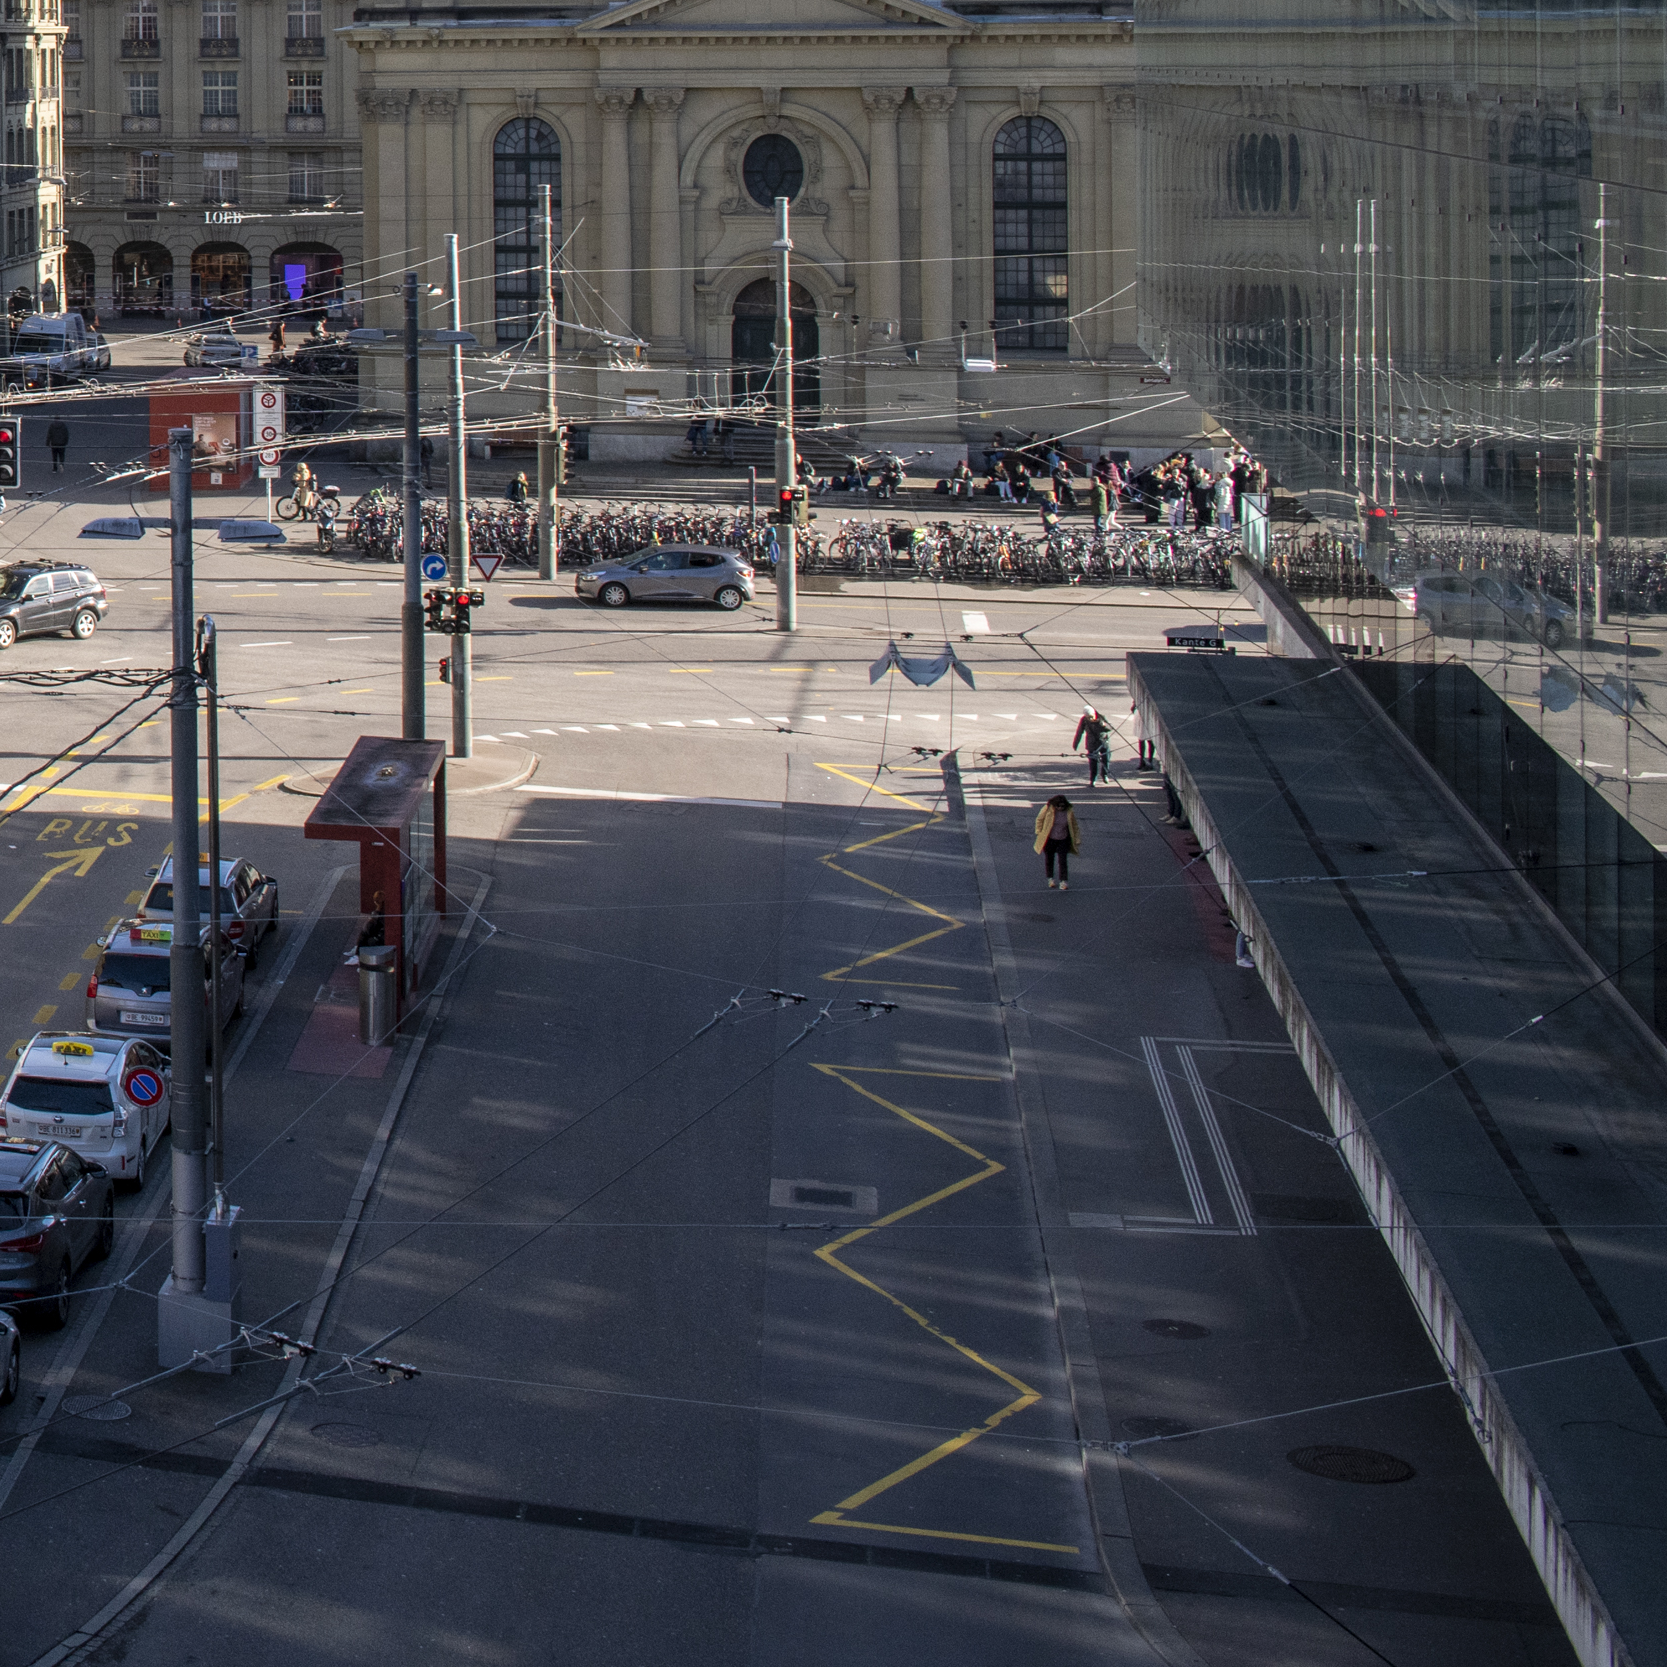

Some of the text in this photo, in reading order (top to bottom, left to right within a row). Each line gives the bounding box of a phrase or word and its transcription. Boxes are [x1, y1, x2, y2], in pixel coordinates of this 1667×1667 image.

[204, 211, 242, 224] LOEB
[1175, 638, 1217, 647] Kante G
[36, 819, 139, 846] BUS
[142, 931, 159, 939] TAXI
[56, 1045, 87, 1054] TAXI
